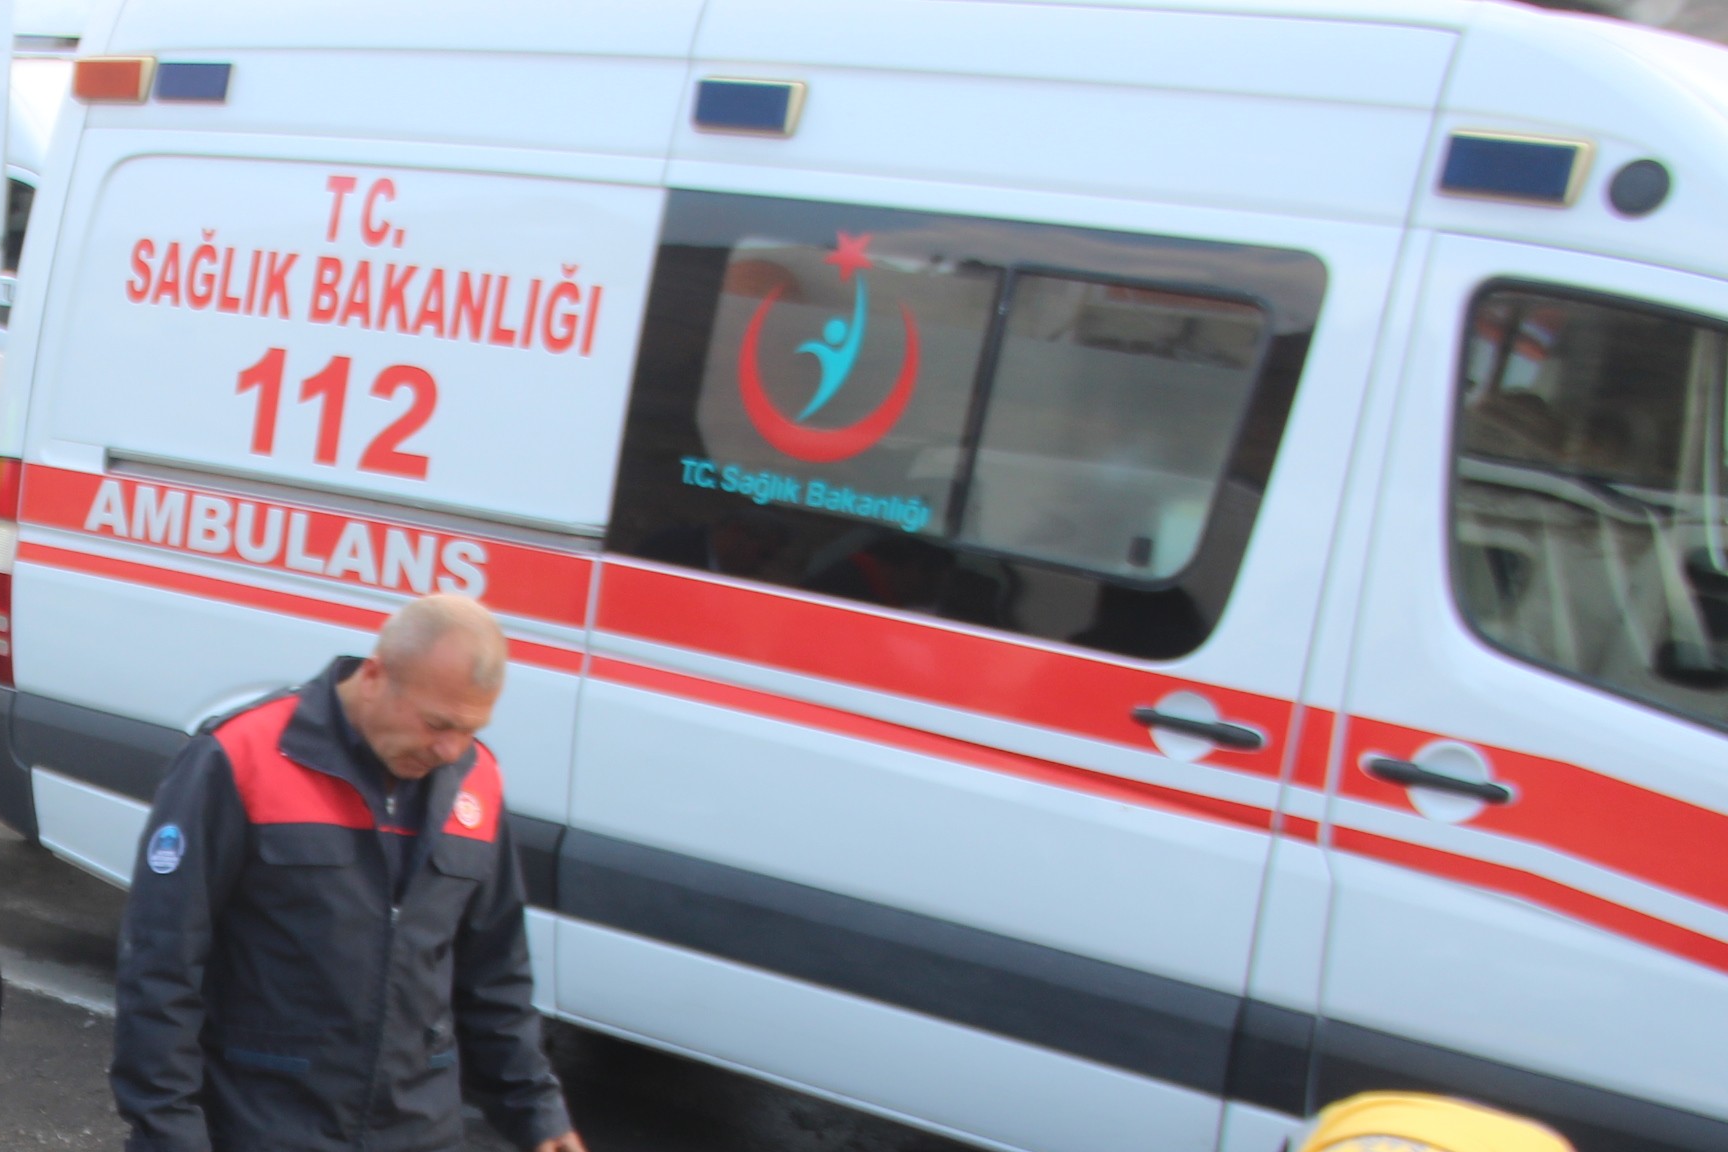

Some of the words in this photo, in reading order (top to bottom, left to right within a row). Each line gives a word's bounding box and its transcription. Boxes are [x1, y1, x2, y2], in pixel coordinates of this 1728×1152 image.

[126, 228, 300, 320] SAĞLIK
[308, 256, 603, 357] BAKANLIĞI
[235, 347, 439, 481] 112
[84, 479, 488, 602] AMBULANS
